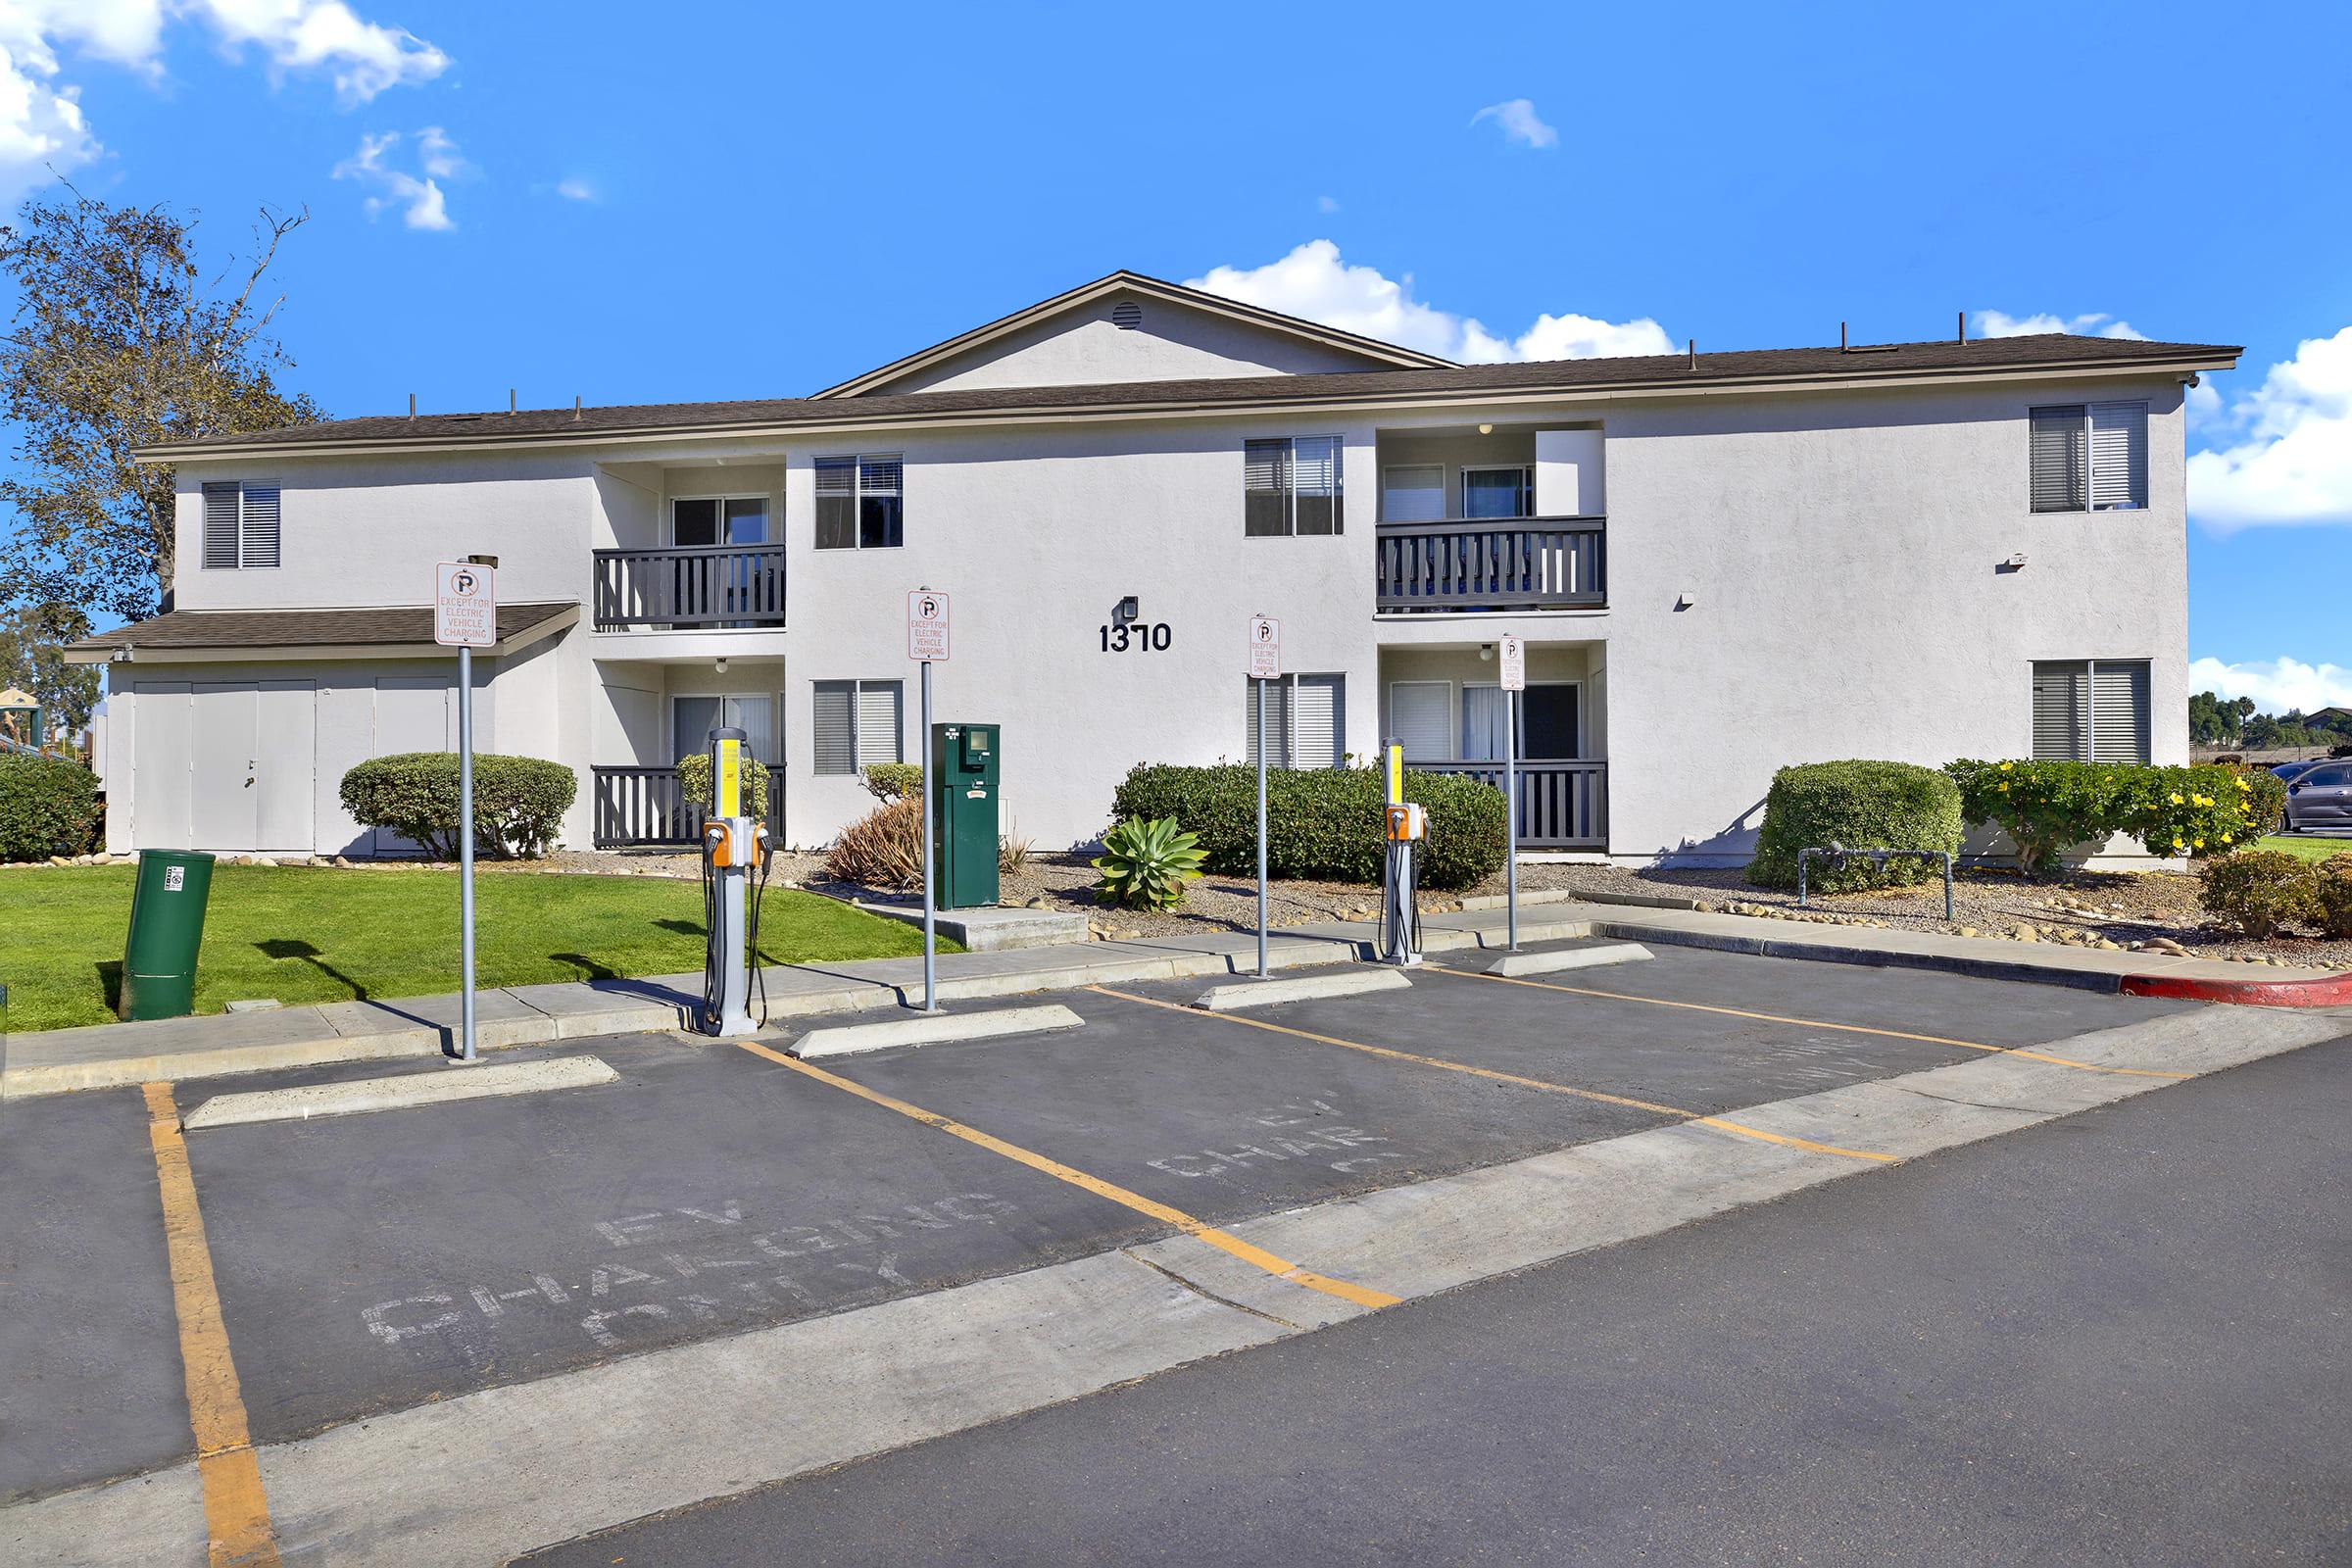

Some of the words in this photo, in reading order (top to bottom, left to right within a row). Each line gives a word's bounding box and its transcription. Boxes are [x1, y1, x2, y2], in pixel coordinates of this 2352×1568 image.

[440, 597, 471, 606] EXCEPT
[474, 599, 489, 608] FOR
[446, 608, 485, 617] ELECTRIC
[448, 617, 483, 628] VEHICLE
[444, 628, 487, 638] CHARGING
[914, 629, 943, 638] ELECTRIC
[1100, 623, 1171, 652] 1370
[916, 638, 942, 647] VEHICLE
[913, 647, 945, 656] CHARGING
[594, 1199, 742, 1249] EV
